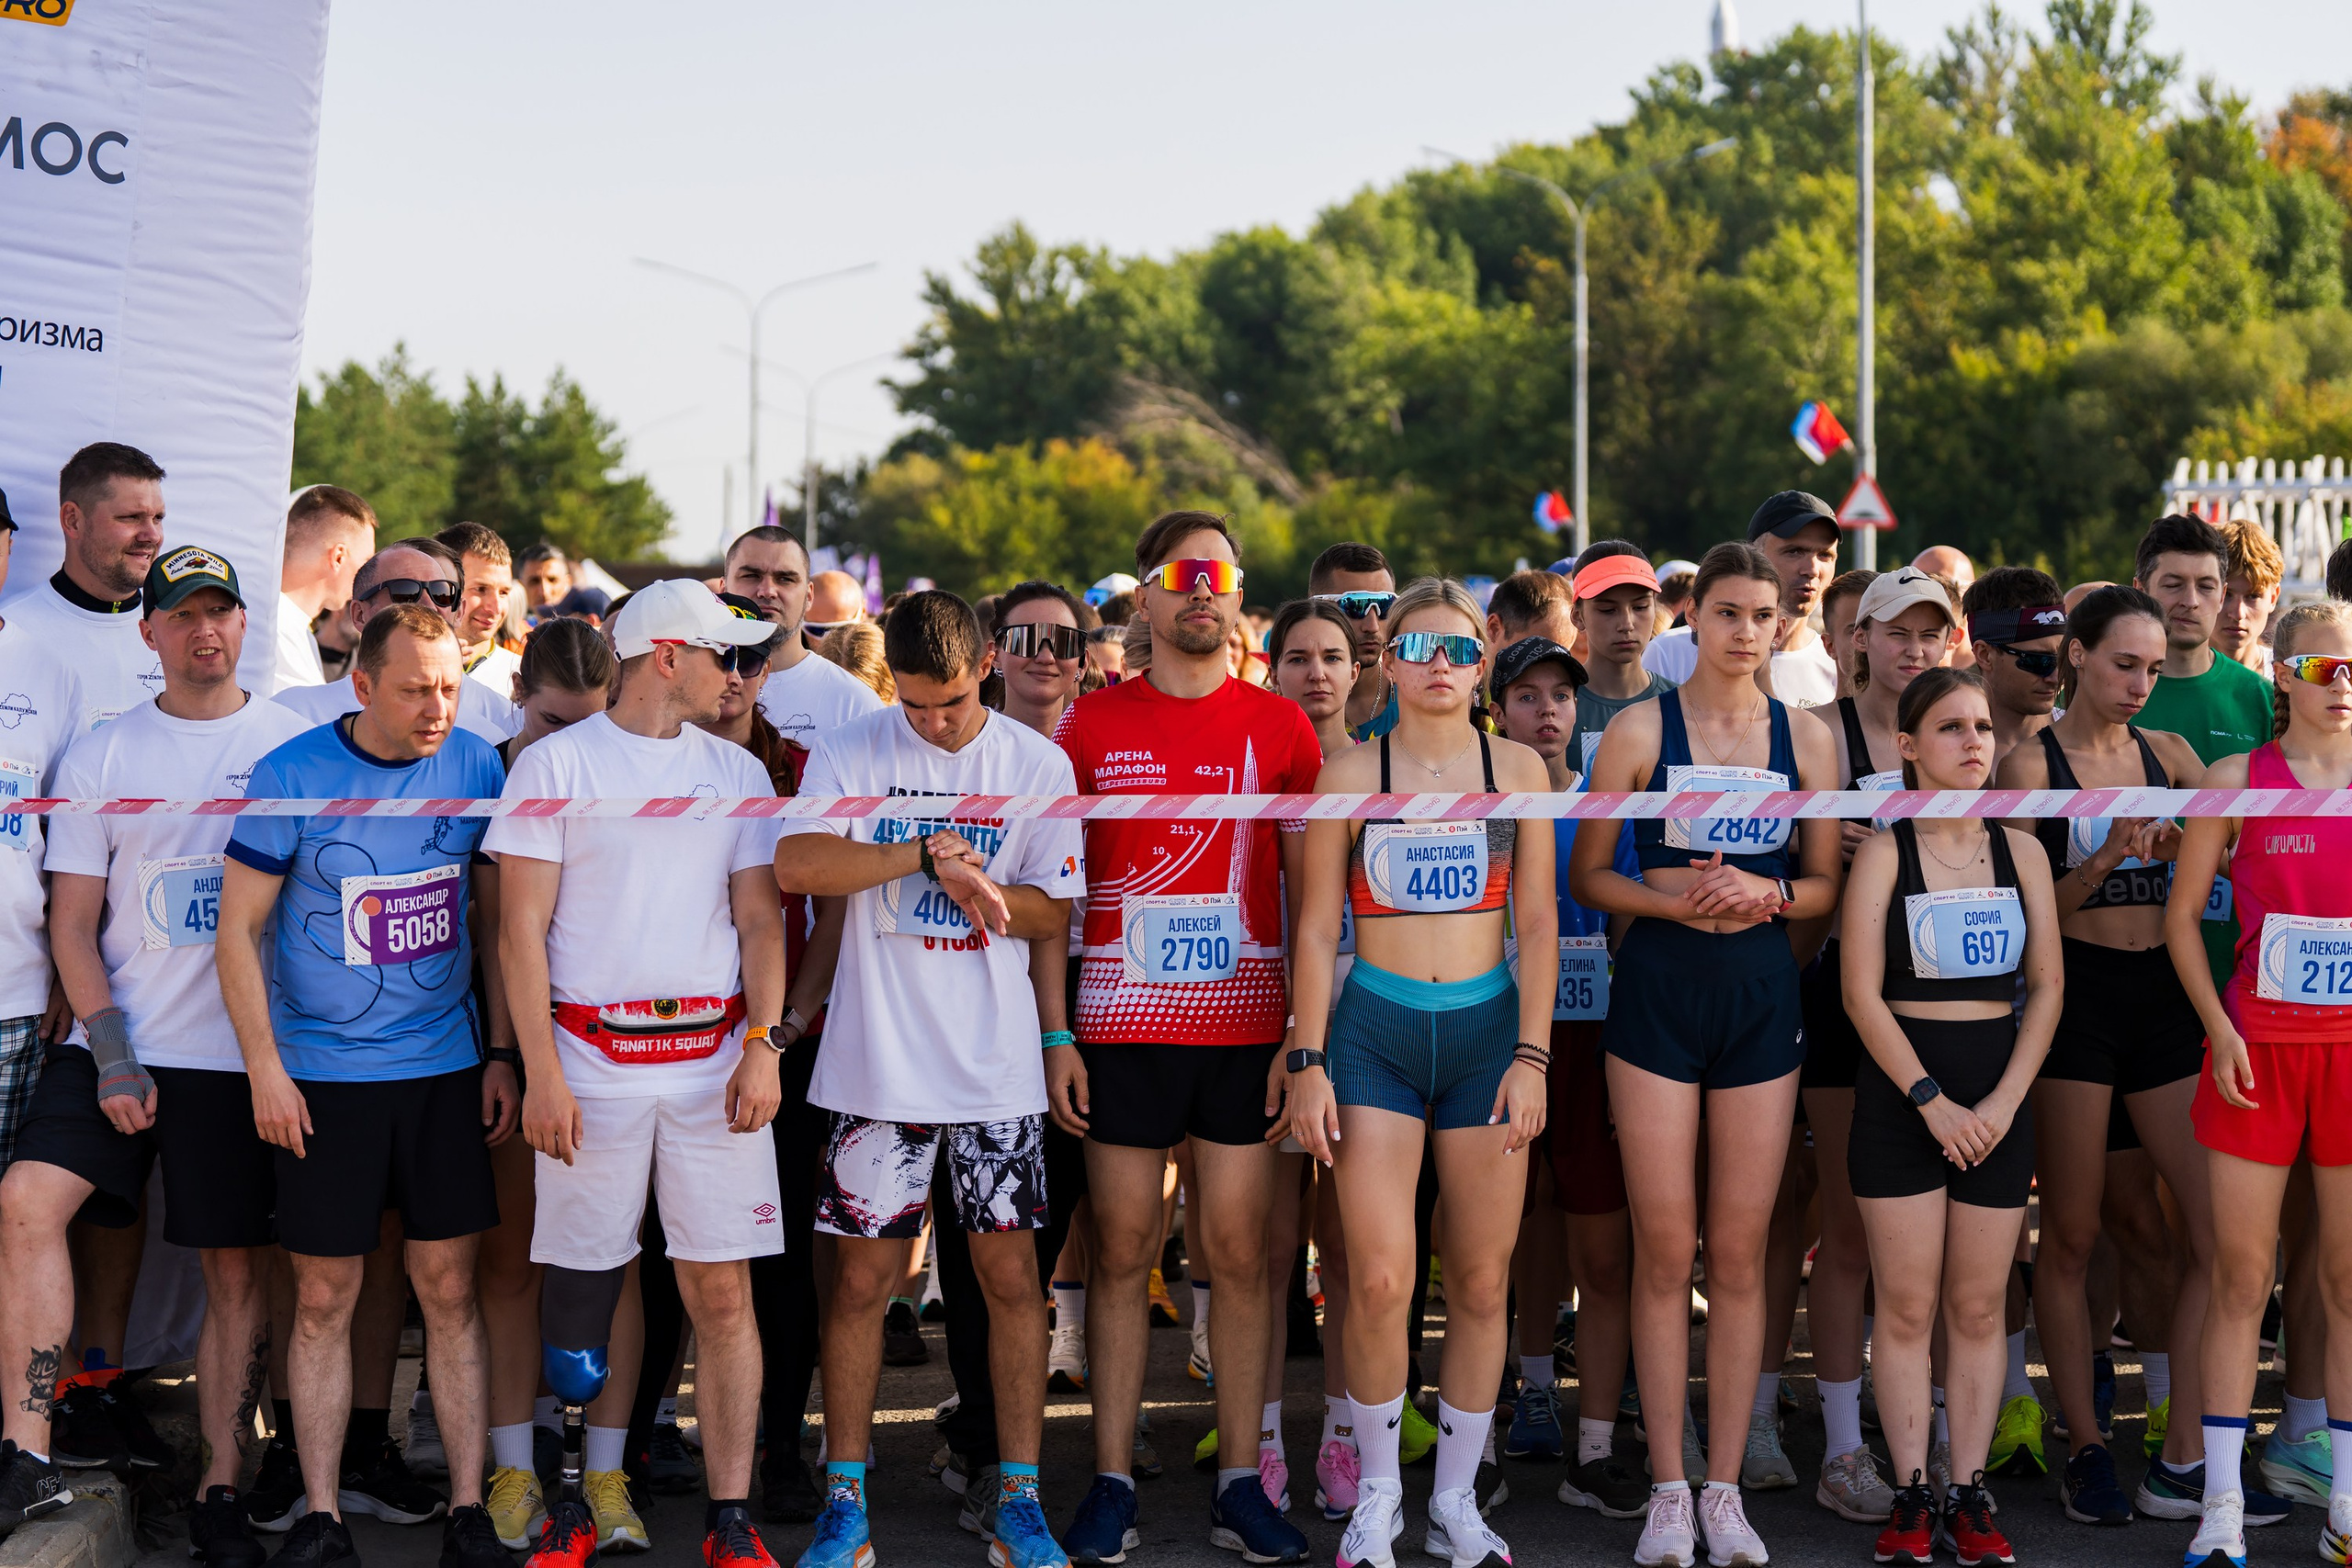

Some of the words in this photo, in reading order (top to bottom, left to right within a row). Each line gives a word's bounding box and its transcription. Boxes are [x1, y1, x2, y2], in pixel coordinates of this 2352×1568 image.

[166, 551, 205, 570] MINNESOTA
[208, 555, 223, 569] WILD
[1104, 751, 1153, 762] АРЕНА
[1095, 764, 1166, 779] МАРАФОН
[1194, 766, 1224, 777] 42,2
[1170, 825, 1195, 837] 21,1
[1152, 847, 1165, 855] 10
[1406, 845, 1475, 862] АНАСТАСИЯ
[1407, 865, 1477, 900] 4403
[385, 888, 449, 914] АЛЕКСАНДР
[185, 897, 220, 932] 45
[1964, 910, 2002, 926] СОФИЯ
[388, 908, 450, 953] 5058
[1169, 915, 1221, 932] АЛЕКСЕЙ
[1161, 937, 1230, 971] 2790
[1962, 930, 2009, 965] 697
[2301, 961, 2352, 994] 212
[612, 1039, 672, 1053] FANAT1K
